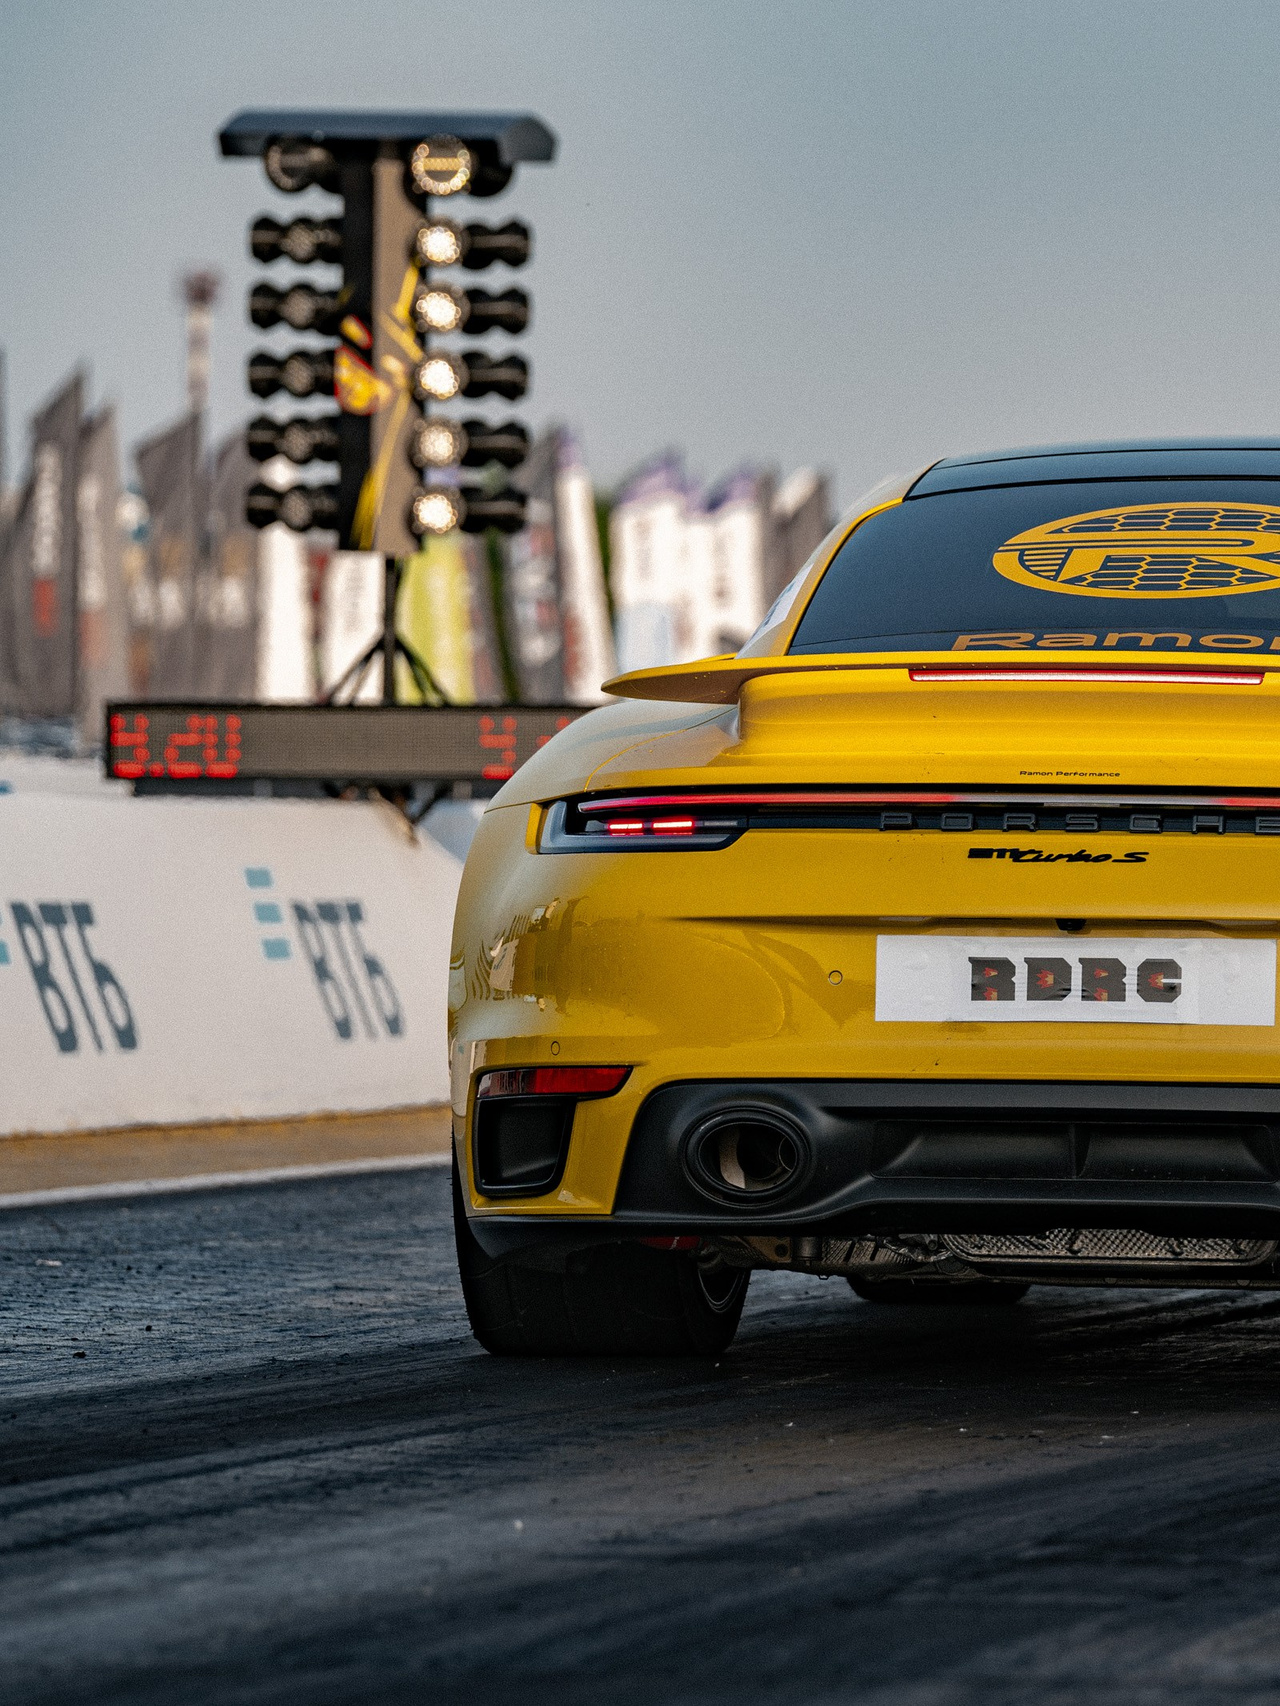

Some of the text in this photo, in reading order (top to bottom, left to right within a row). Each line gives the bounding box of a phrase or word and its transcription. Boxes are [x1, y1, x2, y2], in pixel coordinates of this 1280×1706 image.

[1055, 770, 1121, 778] Performance
[10, 901, 138, 1054] ВТБ
[292, 900, 404, 1040] ВТБ
